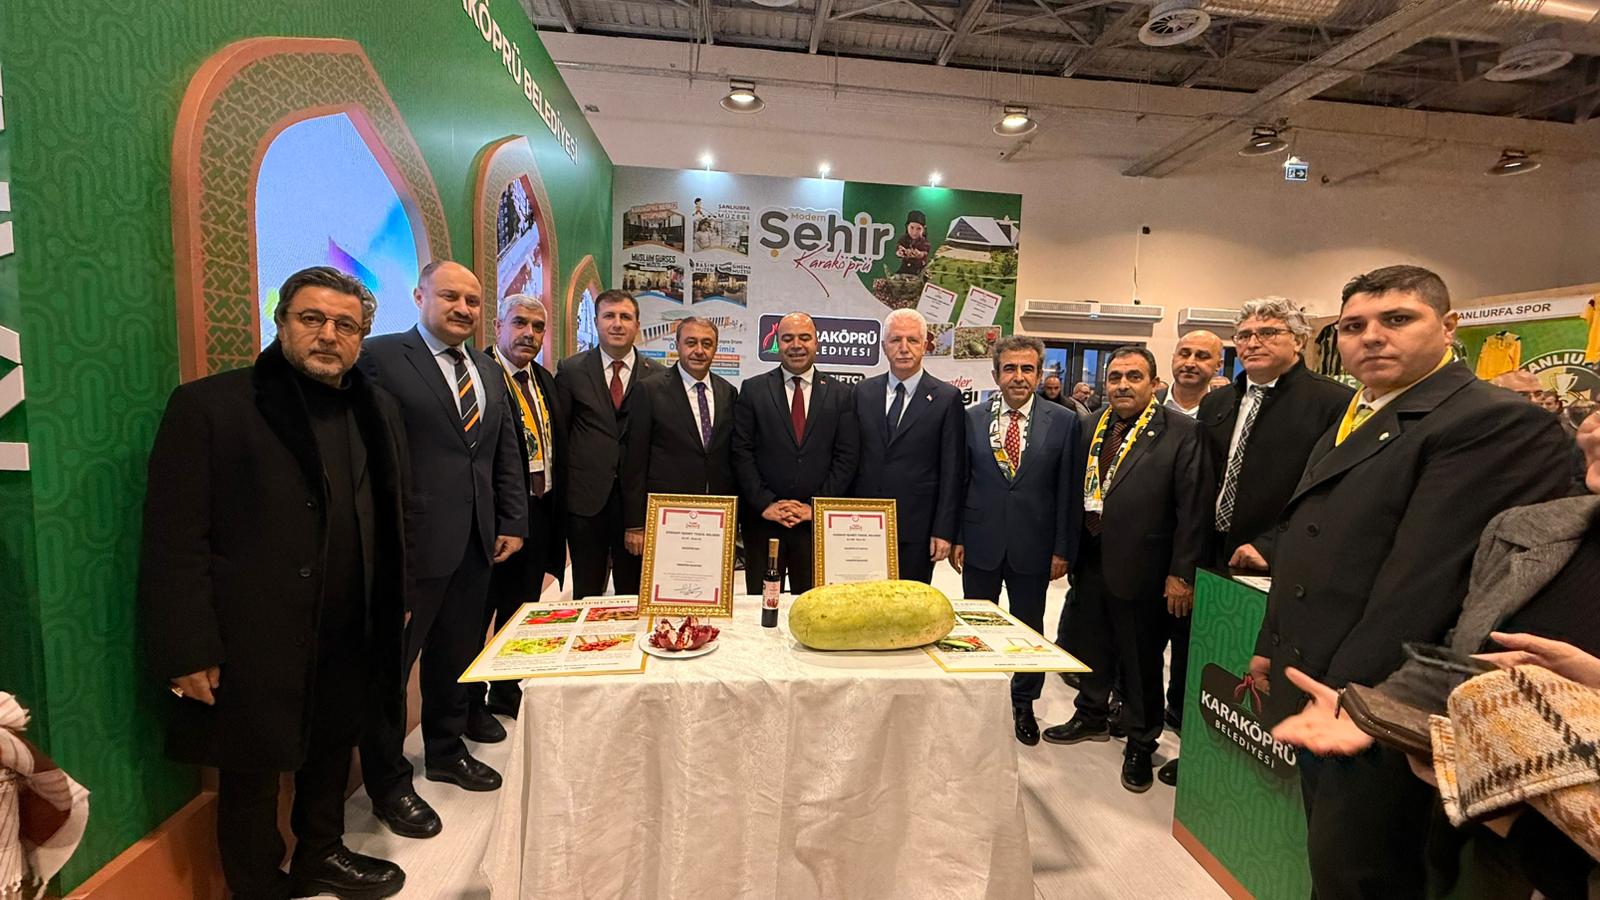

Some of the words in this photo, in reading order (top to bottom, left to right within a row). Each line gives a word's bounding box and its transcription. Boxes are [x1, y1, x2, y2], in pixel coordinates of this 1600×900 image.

[461, 0, 521, 84] KÖPRÜ
[523, 67, 578, 165] BELEDİYESİ
[760, 210, 890, 261] Şehir
[790, 212, 826, 223] Modern
[793, 243, 873, 298] Karaköprü
[1458, 307, 1513, 320] ANLIURFA
[1515, 303, 1552, 315] SPOR
[816, 329, 877, 345] AKÖPRÜ
[1528, 353, 1586, 374] ANLIU
[1201, 690, 1297, 766] KARAKÖPRÜ
